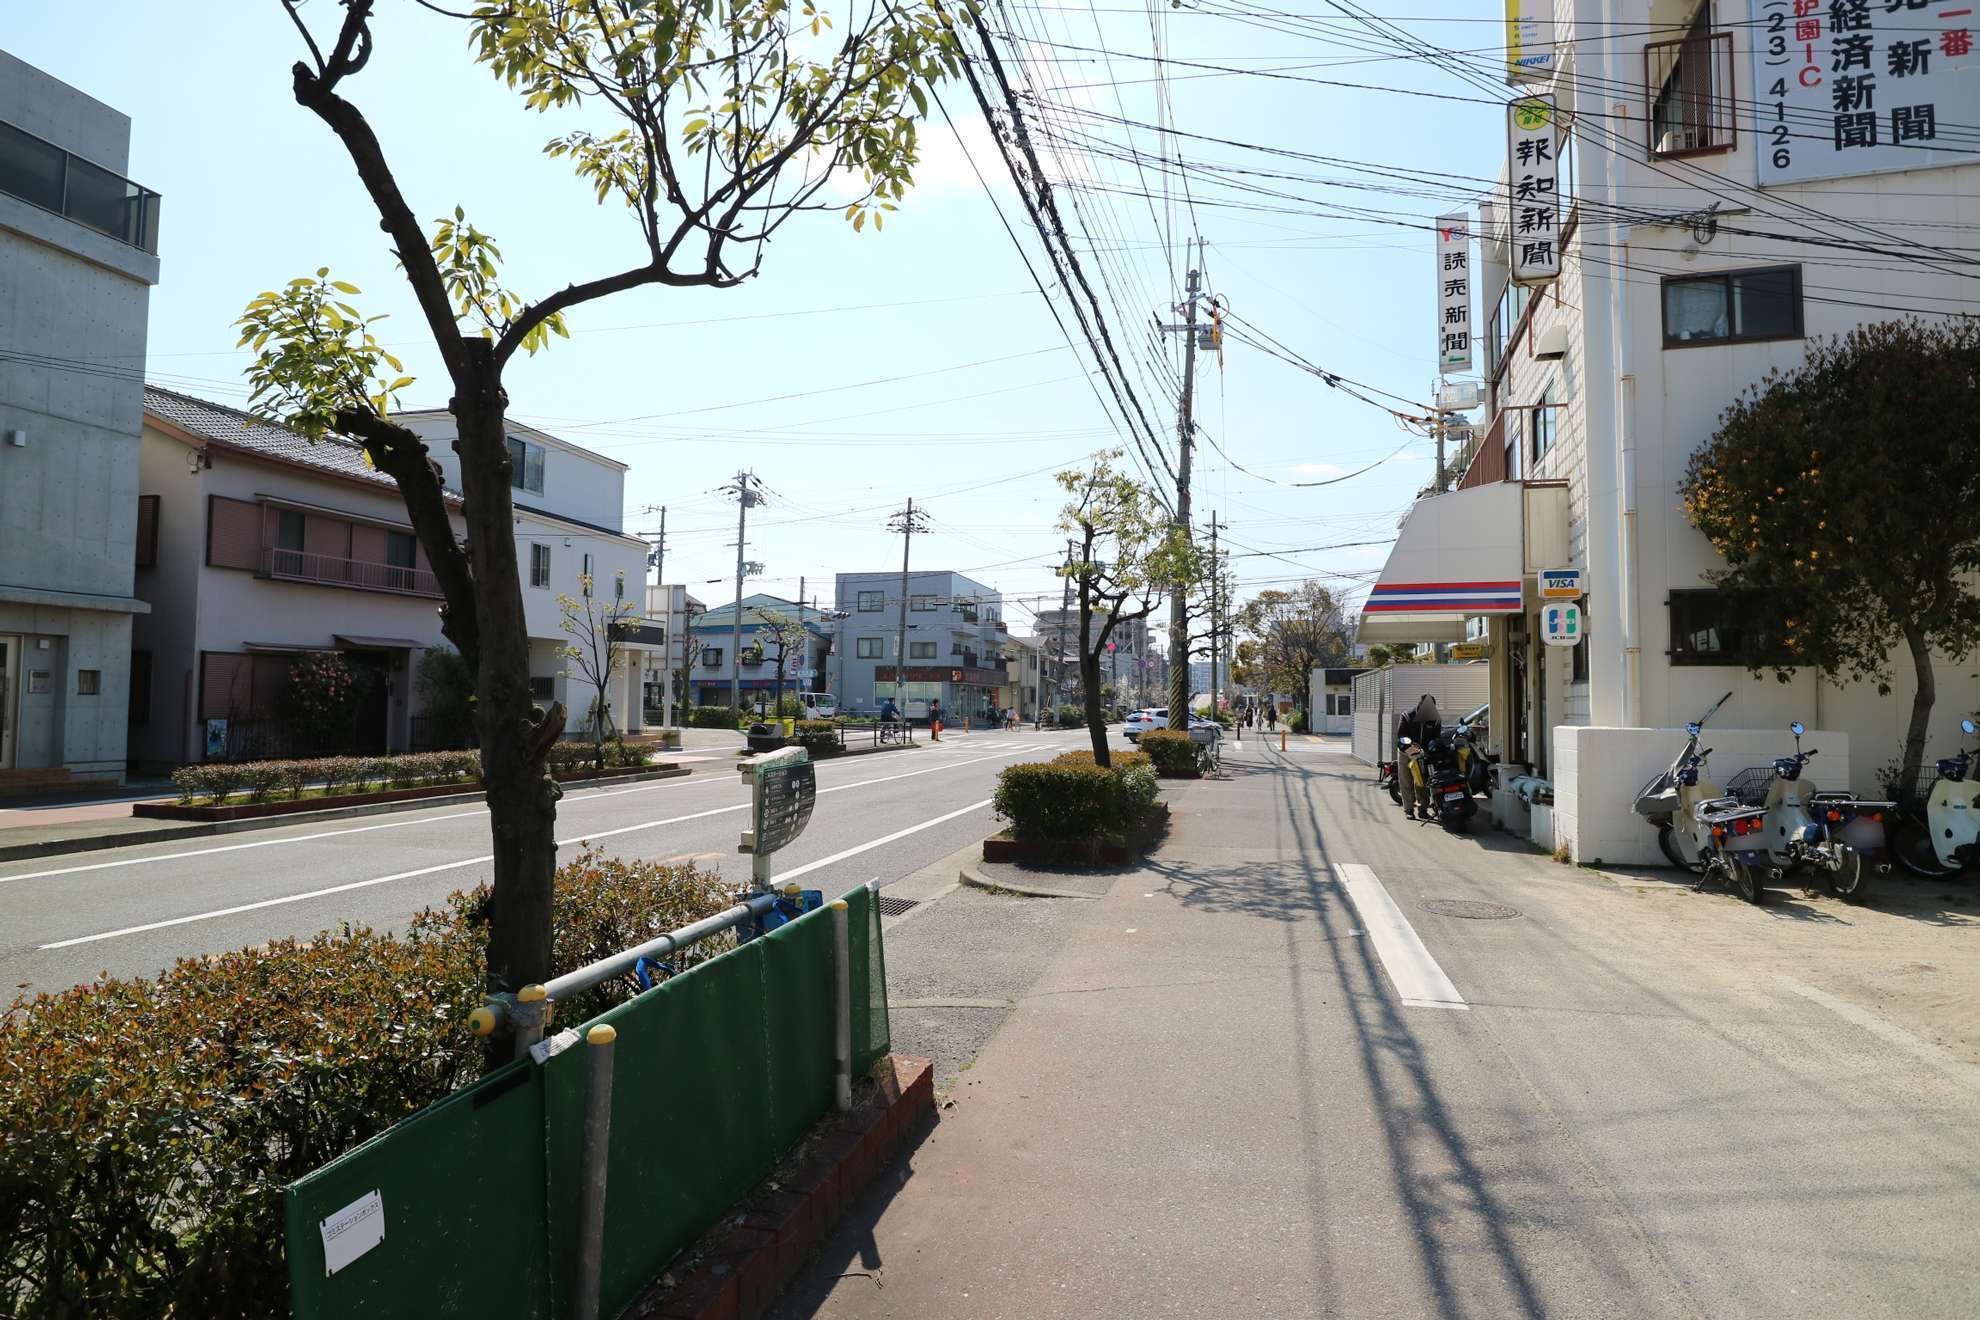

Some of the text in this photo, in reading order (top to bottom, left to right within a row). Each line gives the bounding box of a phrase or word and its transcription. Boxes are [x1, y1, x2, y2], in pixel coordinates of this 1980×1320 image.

[1515, 54, 1550, 66] NIKKEI
[1938, 9, 1973, 56] 一番
[1829, 0, 1877, 151] 経済新聞
[1516, 138, 1555, 268] 報知新聞
[1444, 252, 1468, 351] 読売新聞
[1549, 579, 1575, 588] VISA
